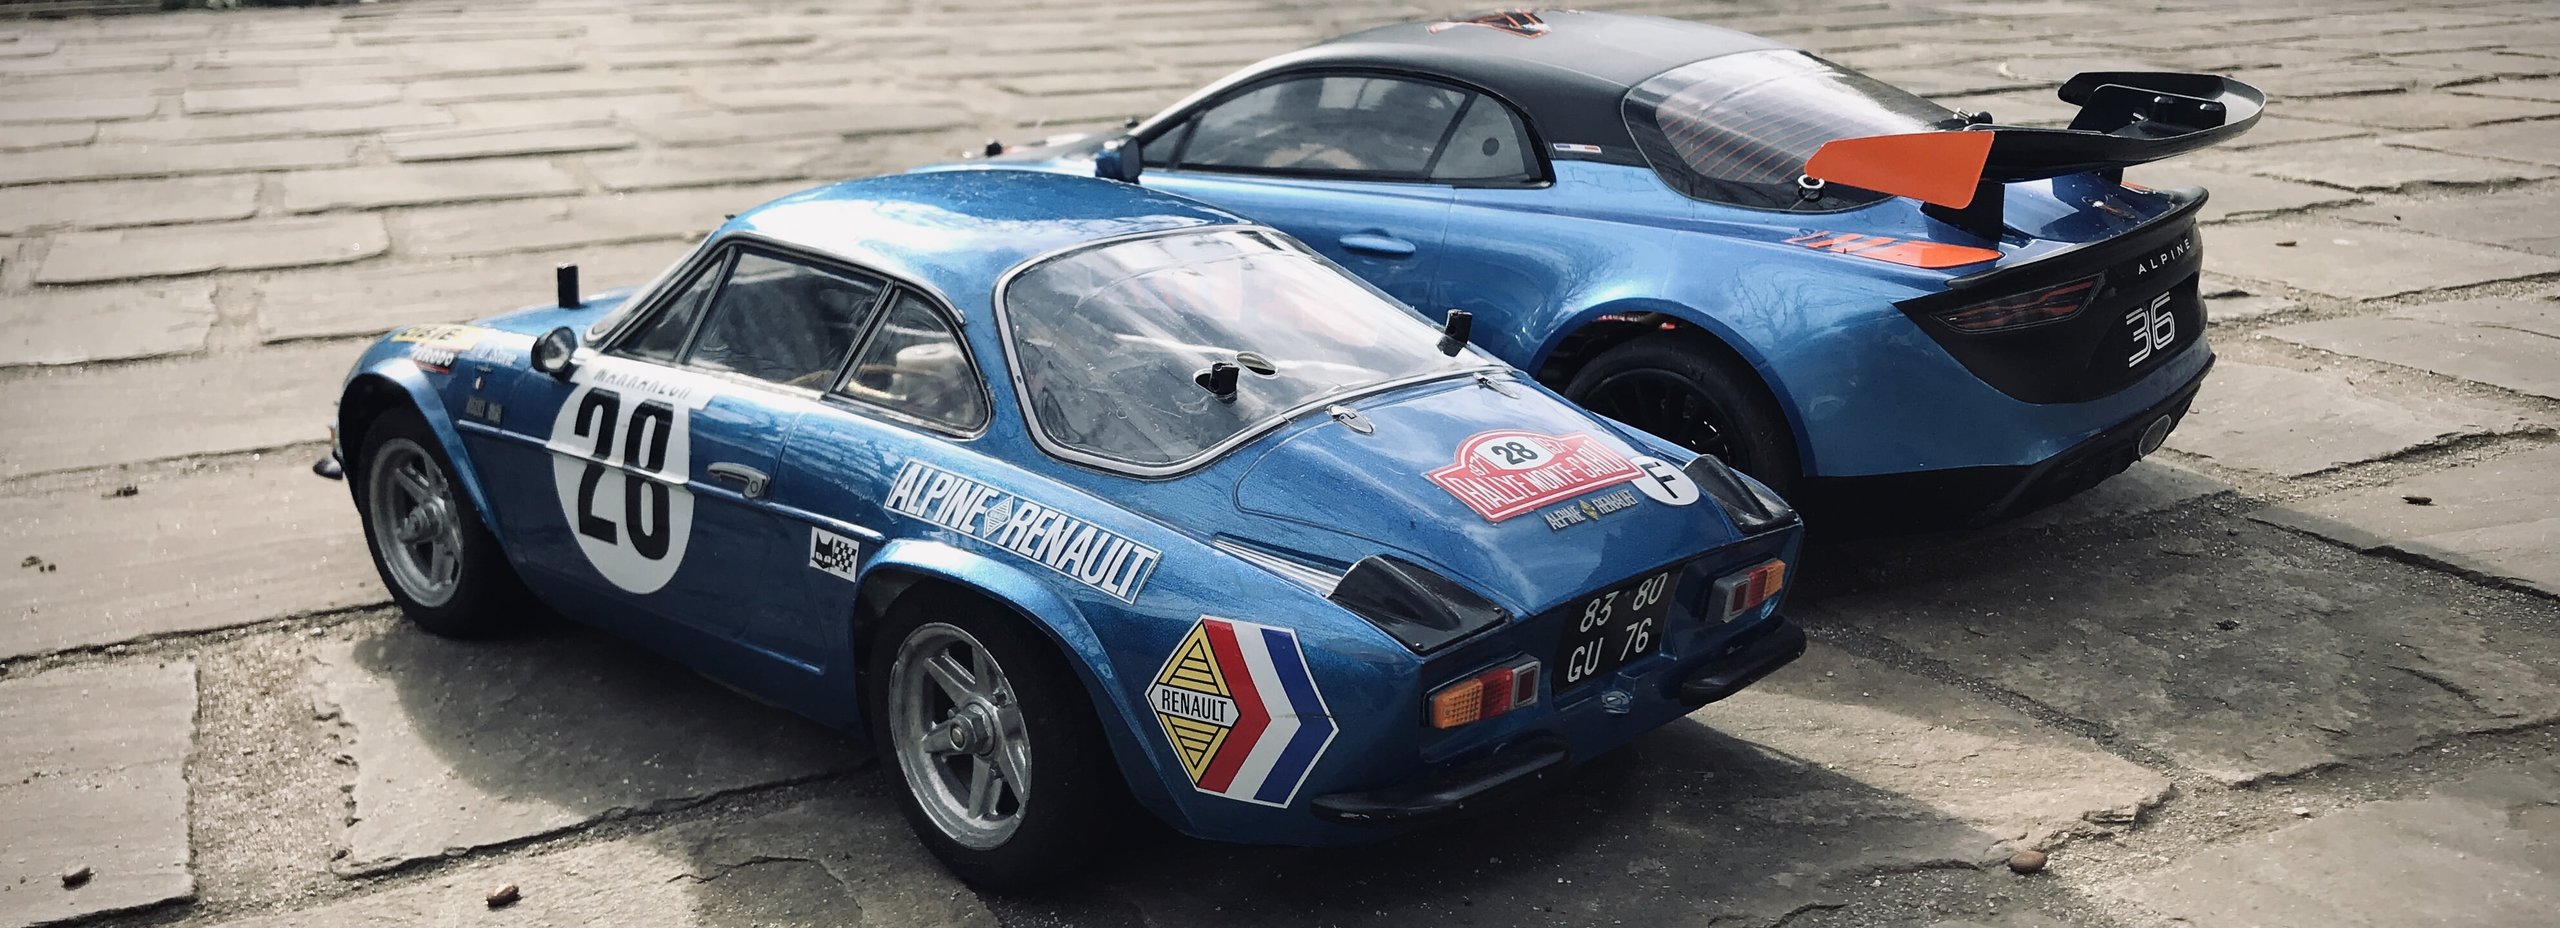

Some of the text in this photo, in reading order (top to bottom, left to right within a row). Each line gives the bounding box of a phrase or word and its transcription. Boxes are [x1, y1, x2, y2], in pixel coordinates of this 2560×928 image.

[2138, 238, 2191, 275] ALPINE
[2125, 291, 2176, 368] 36
[574, 386, 674, 561] 28
[1491, 441, 1539, 465] 28
[1446, 474, 1538, 511] RALLYE
[1640, 461, 1679, 499] F
[887, 463, 1155, 598] ALPINE RENAULT
[1544, 488, 1639, 531] ALPINE RENAULT
[1580, 572, 1669, 633] 83 80
[1567, 617, 1652, 683] GU 76
[1161, 688, 1228, 723] RENAULT
